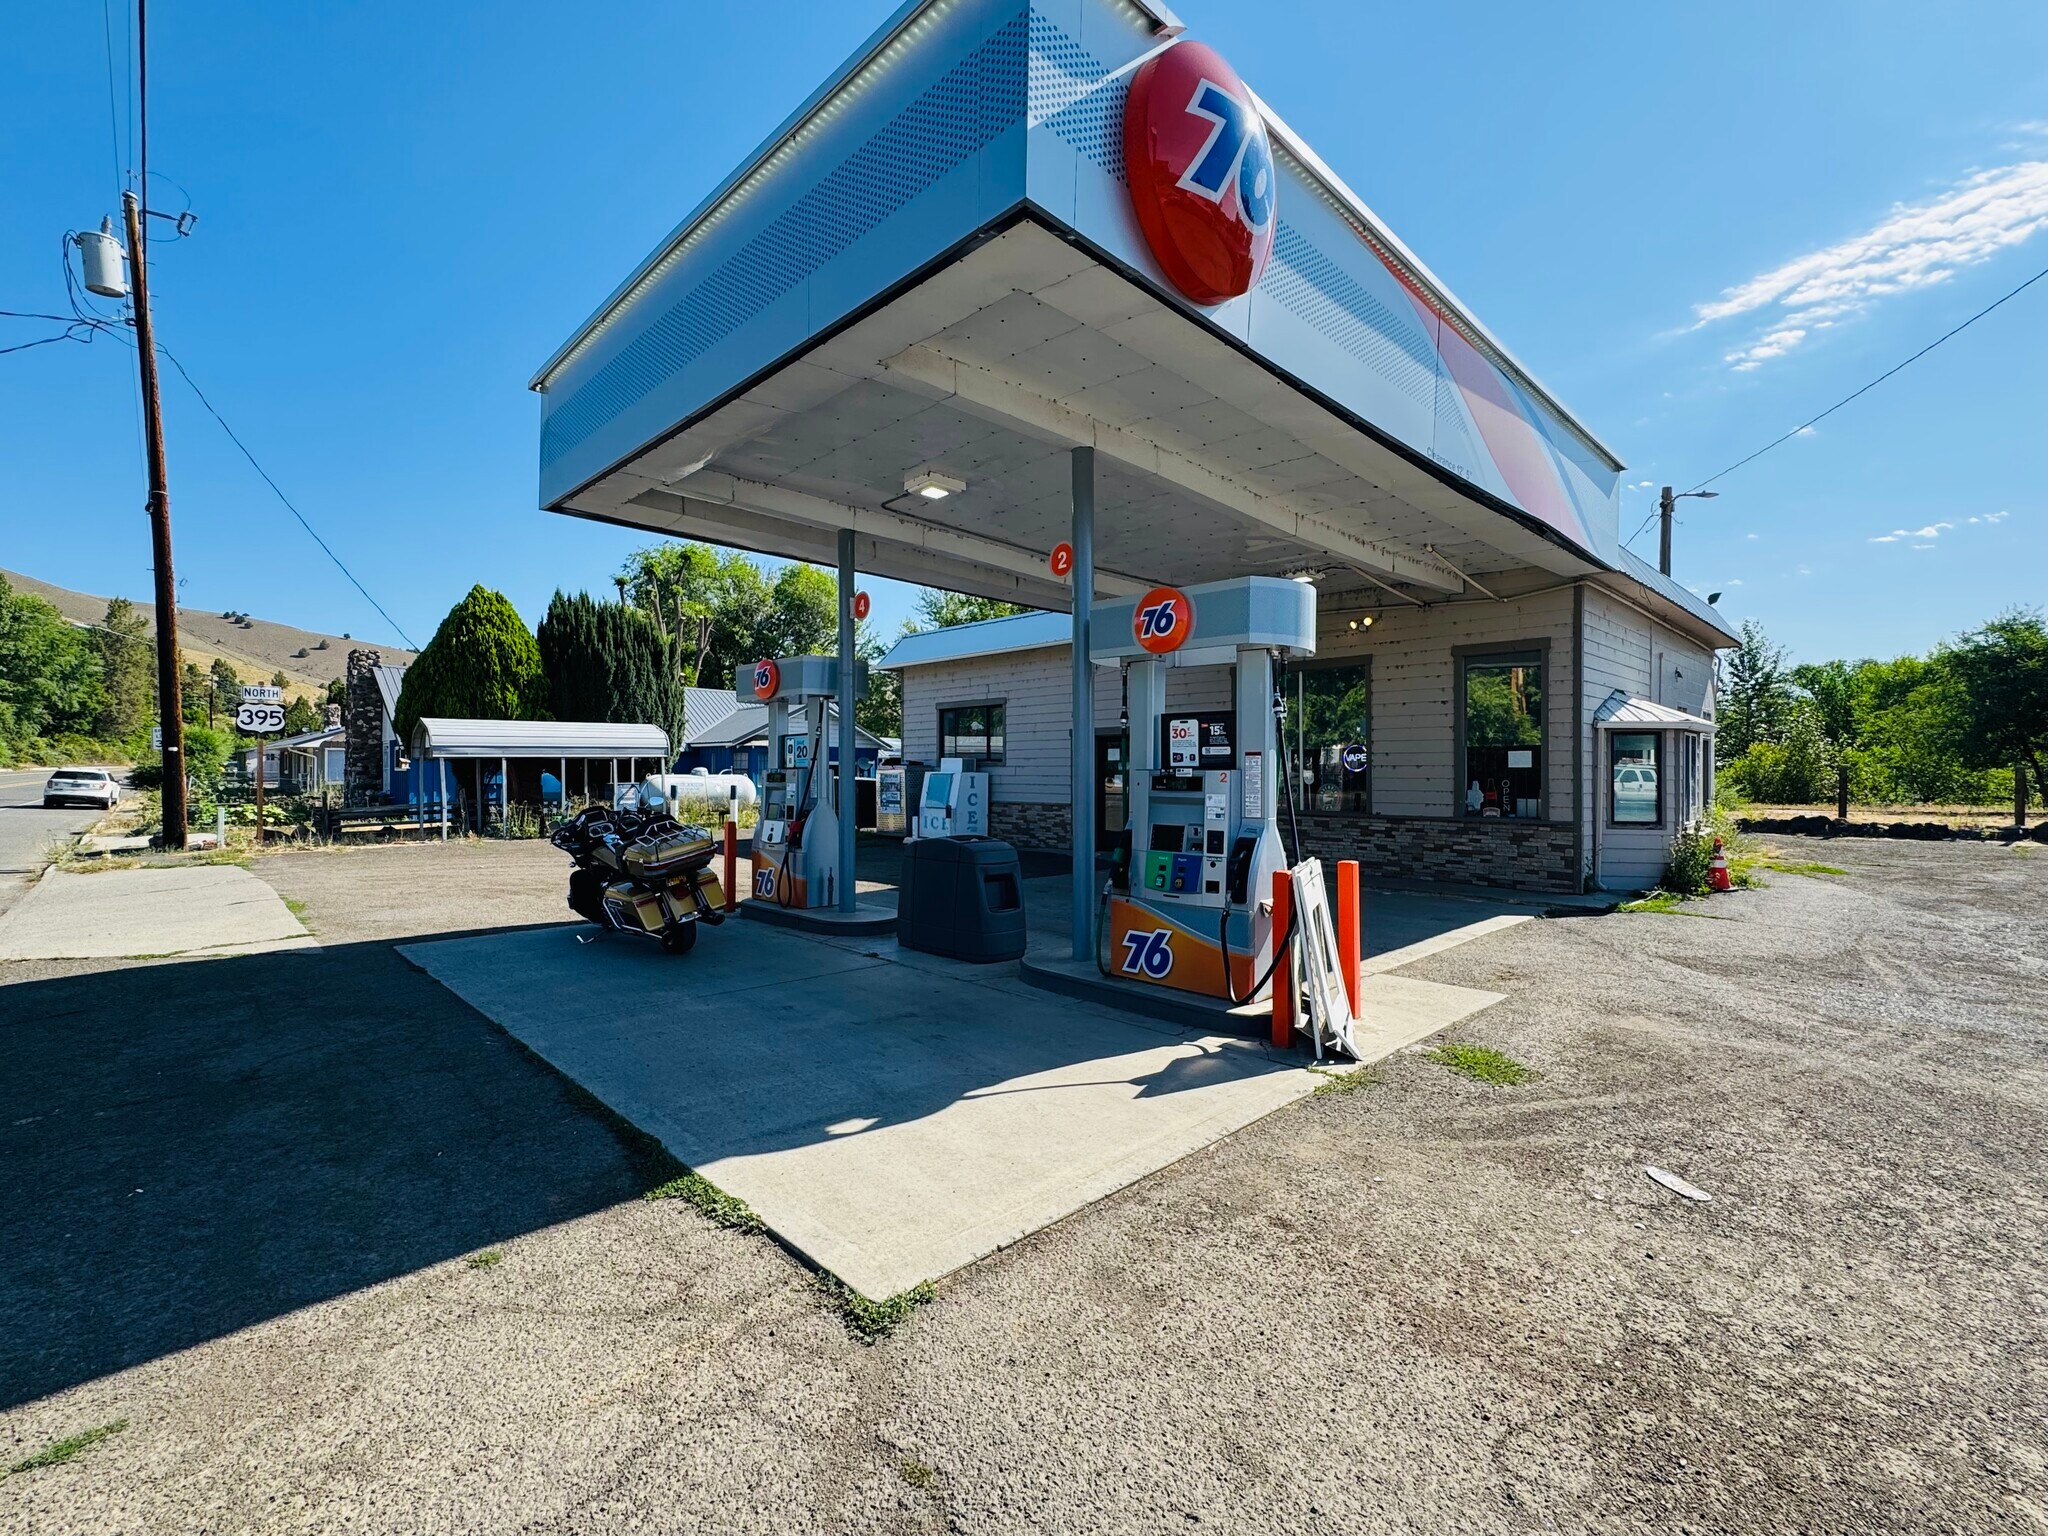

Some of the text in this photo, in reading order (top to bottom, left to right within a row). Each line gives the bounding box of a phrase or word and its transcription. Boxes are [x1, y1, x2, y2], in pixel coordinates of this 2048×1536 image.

[1175, 77, 1276, 236] 76
[1427, 446, 1455, 471] Clearance
[1058, 551, 1067, 569] 2
[858, 599, 866, 613] 4
[1140, 599, 1177, 639] 76
[755, 666, 771, 690] 76
[244, 687, 279, 698] NORTH
[240, 709, 283, 727] 395
[796, 745, 808, 758] 20
[1345, 753, 1367, 762] VAPE
[1220, 772, 1228, 783] 2
[967, 775, 978, 825] ICE
[1501, 780, 1511, 812] OPEN
[756, 867, 775, 898] 76
[1122, 928, 1173, 979] 76
